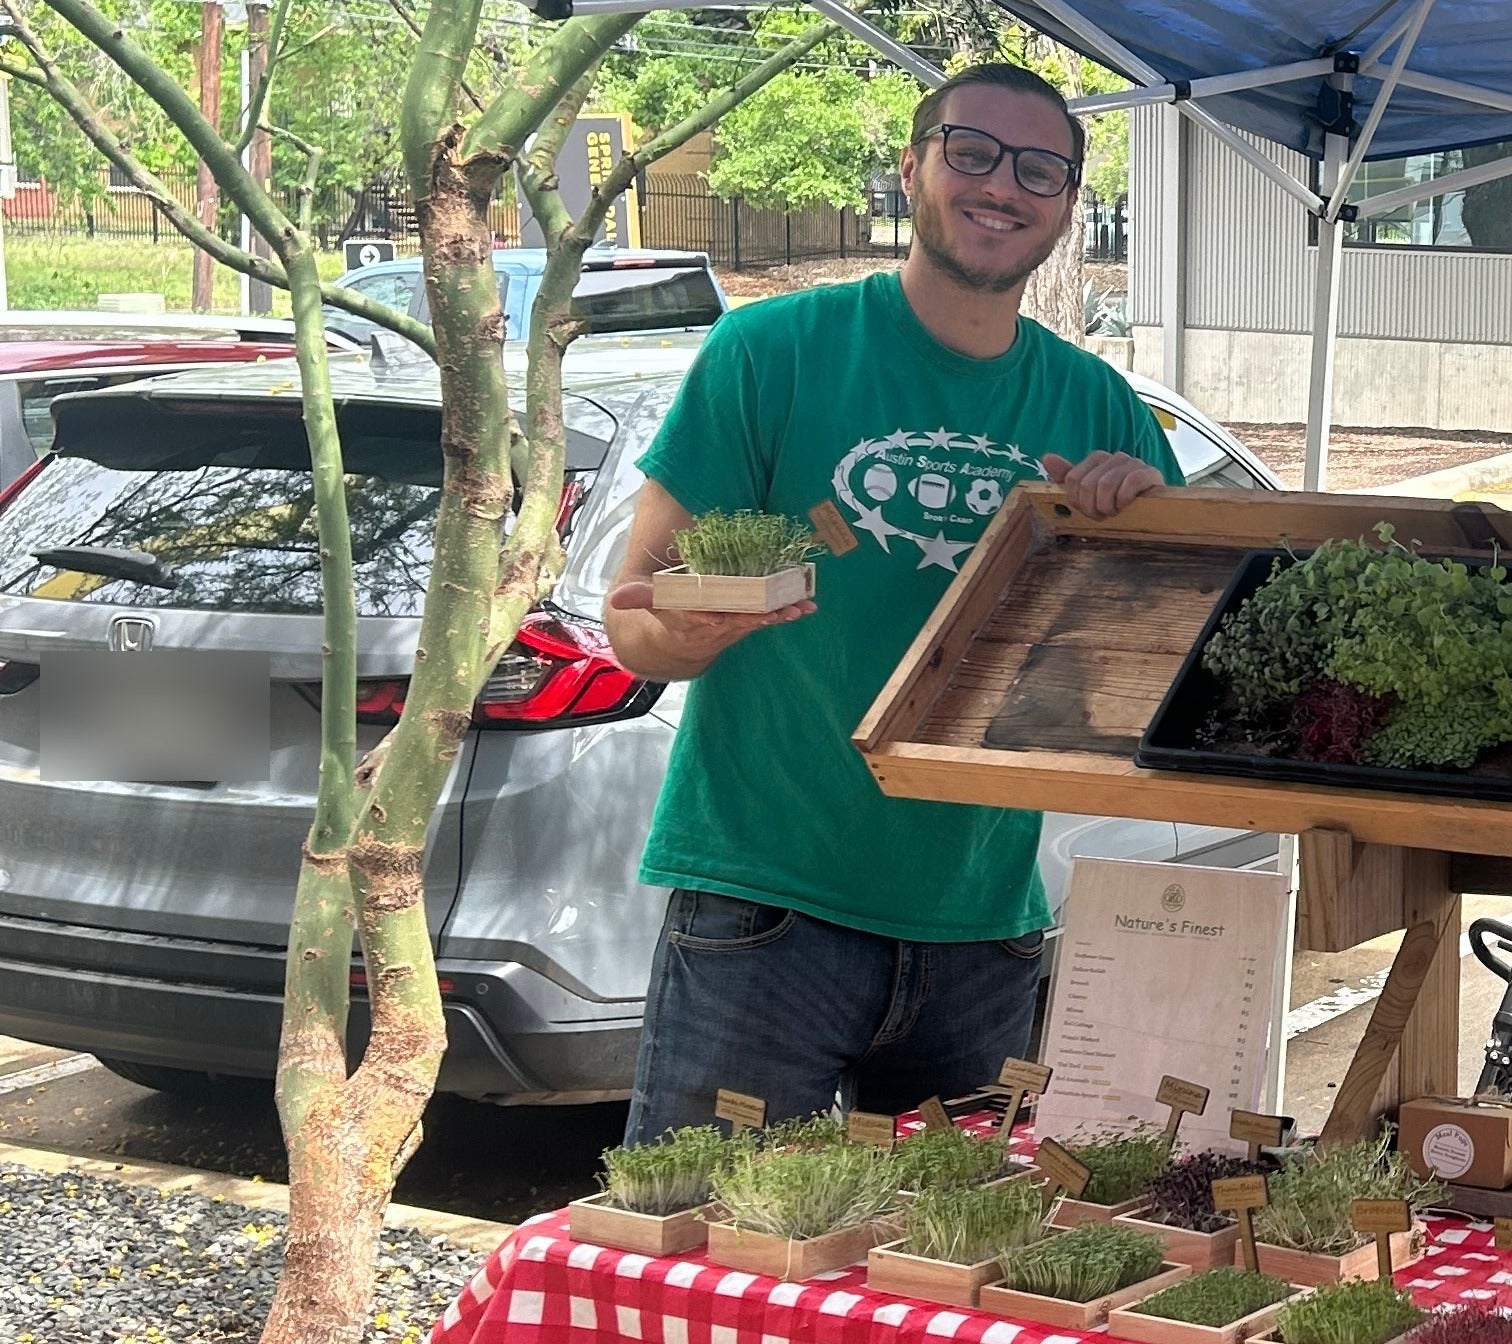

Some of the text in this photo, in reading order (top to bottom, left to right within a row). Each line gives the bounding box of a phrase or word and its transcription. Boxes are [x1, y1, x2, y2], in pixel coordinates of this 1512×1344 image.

[875, 450, 914, 466] Austin
[916, 455, 958, 473] Sports
[1114, 914, 1178, 932] Nature's
[1181, 920, 1225, 937] Finest
